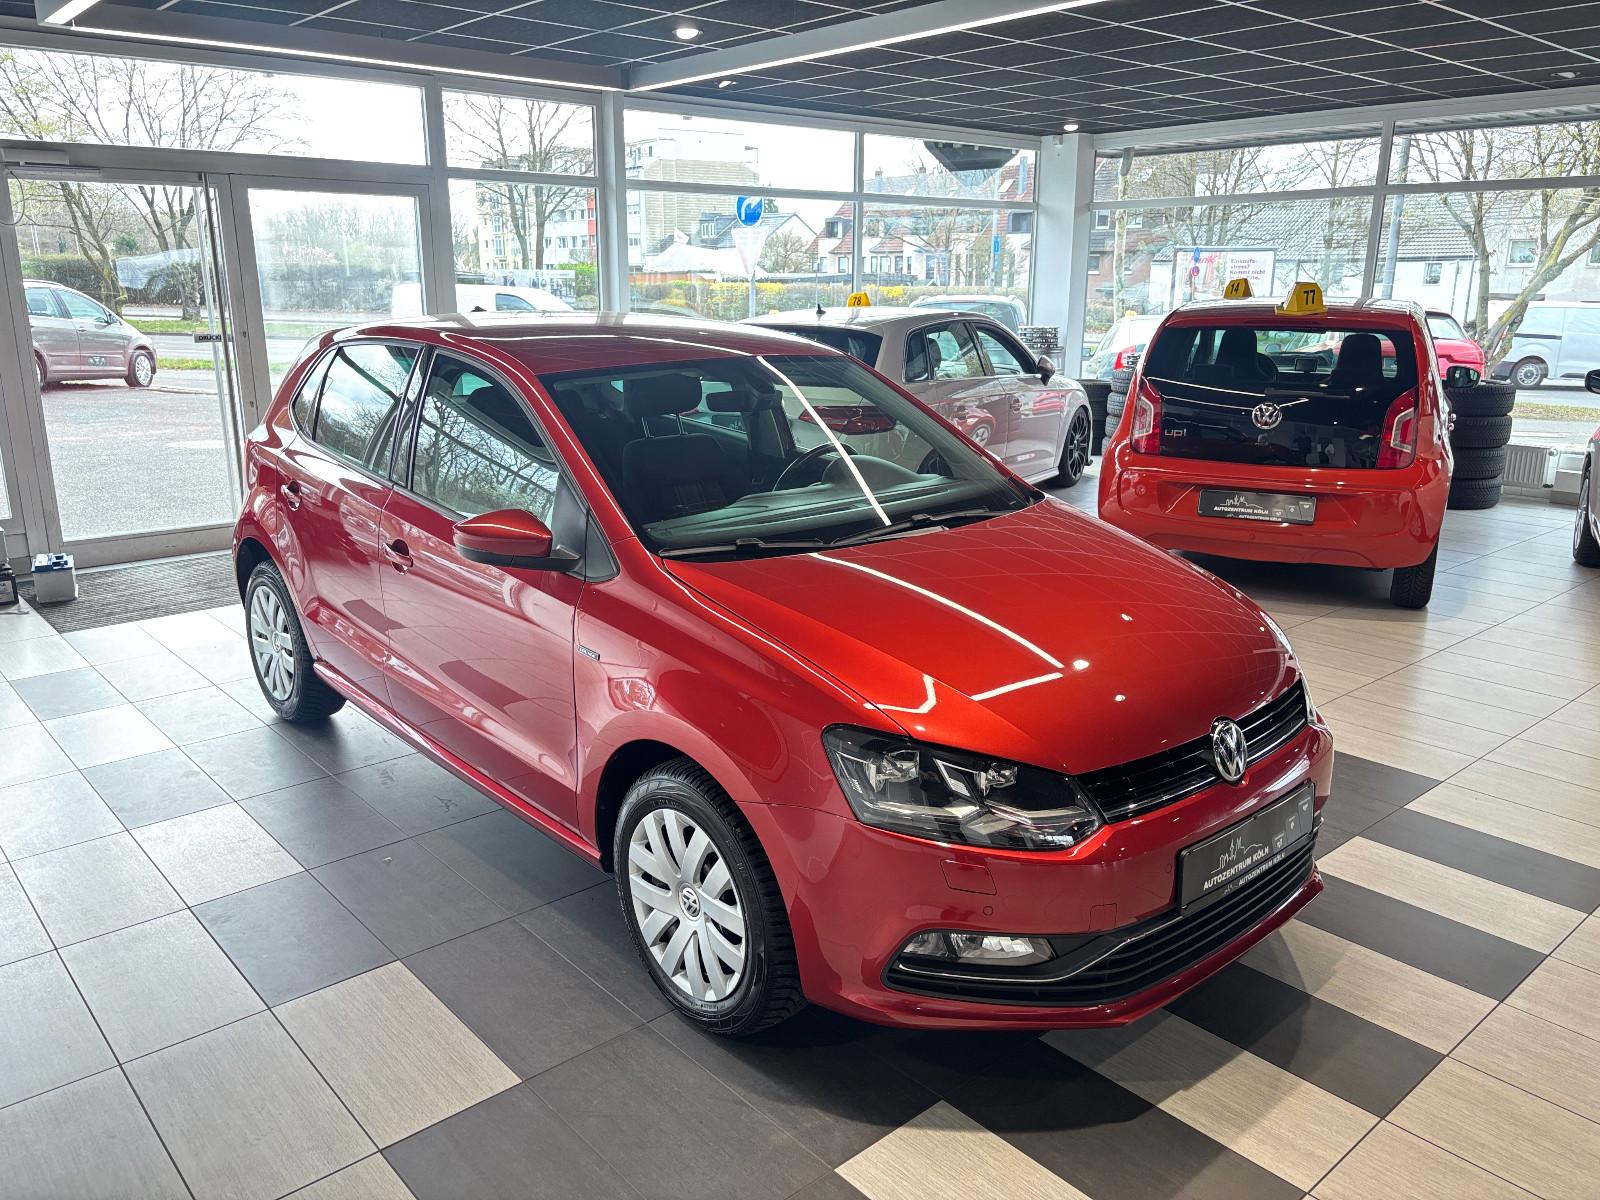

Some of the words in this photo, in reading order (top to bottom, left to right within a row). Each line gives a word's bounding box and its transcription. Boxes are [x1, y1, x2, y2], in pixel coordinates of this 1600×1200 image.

[1230, 282, 1240, 295] 14
[852, 295, 862, 307] 78
[1303, 289, 1316, 305] 77
[1164, 428, 1187, 438] up!
[1203, 857, 1252, 891] AUTOZENTRUM
[1252, 845, 1269, 862] KÖLN
